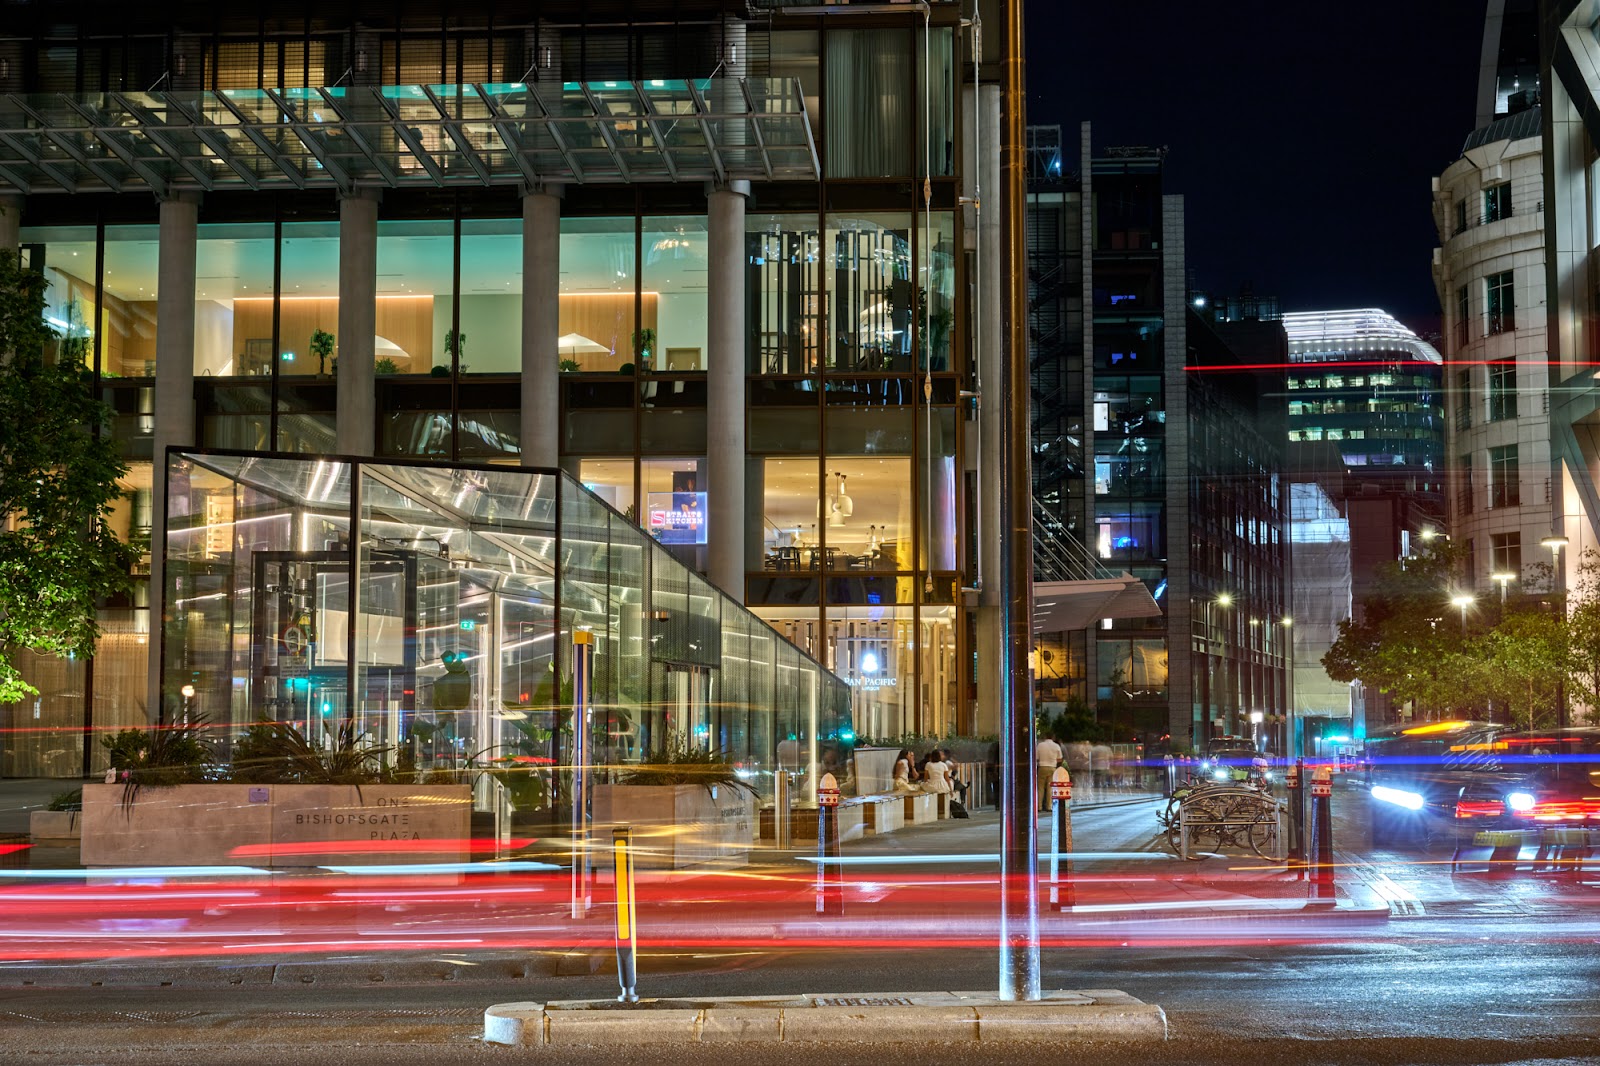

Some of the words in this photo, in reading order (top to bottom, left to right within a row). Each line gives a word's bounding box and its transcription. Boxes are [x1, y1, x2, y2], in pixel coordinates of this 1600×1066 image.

[844, 677, 861, 686] PAN
[865, 677, 896, 686] PACIFIC
[377, 797, 409, 808] ONE
[296, 814, 409, 825] BISHOPSGATE
[370, 831, 420, 841] PLAZA
